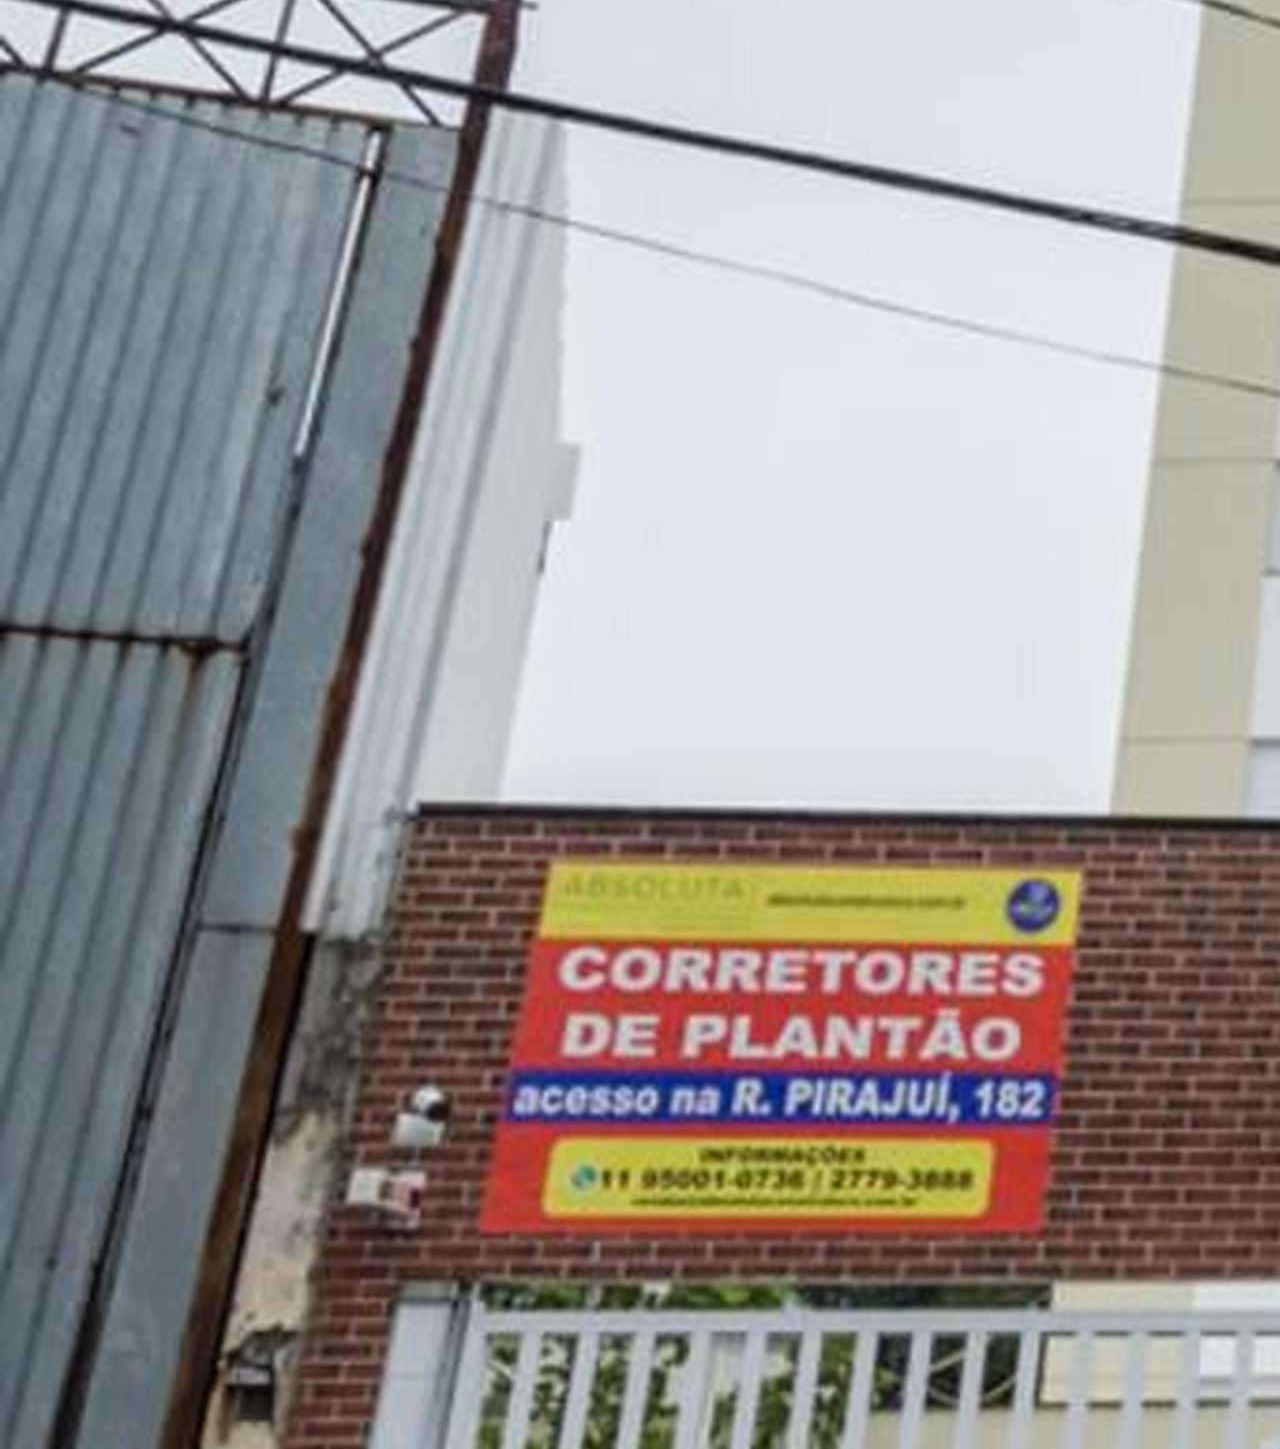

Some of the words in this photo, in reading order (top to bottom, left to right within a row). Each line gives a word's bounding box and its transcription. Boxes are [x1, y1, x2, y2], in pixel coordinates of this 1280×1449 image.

[558, 946, 1045, 996] CORRETORES
[560, 1013, 660, 1058] DE
[681, 1008, 1022, 1061] PLANTÃO
[513, 1085, 658, 1115] acesso
[669, 1086, 720, 1115] na
[731, 1078, 772, 1116] R.
[784, 1071, 960, 1124] PIRAJUÍ,
[975, 1081, 1046, 1118] 182
[699, 1145, 865, 1165] INFORMAÇÕES
